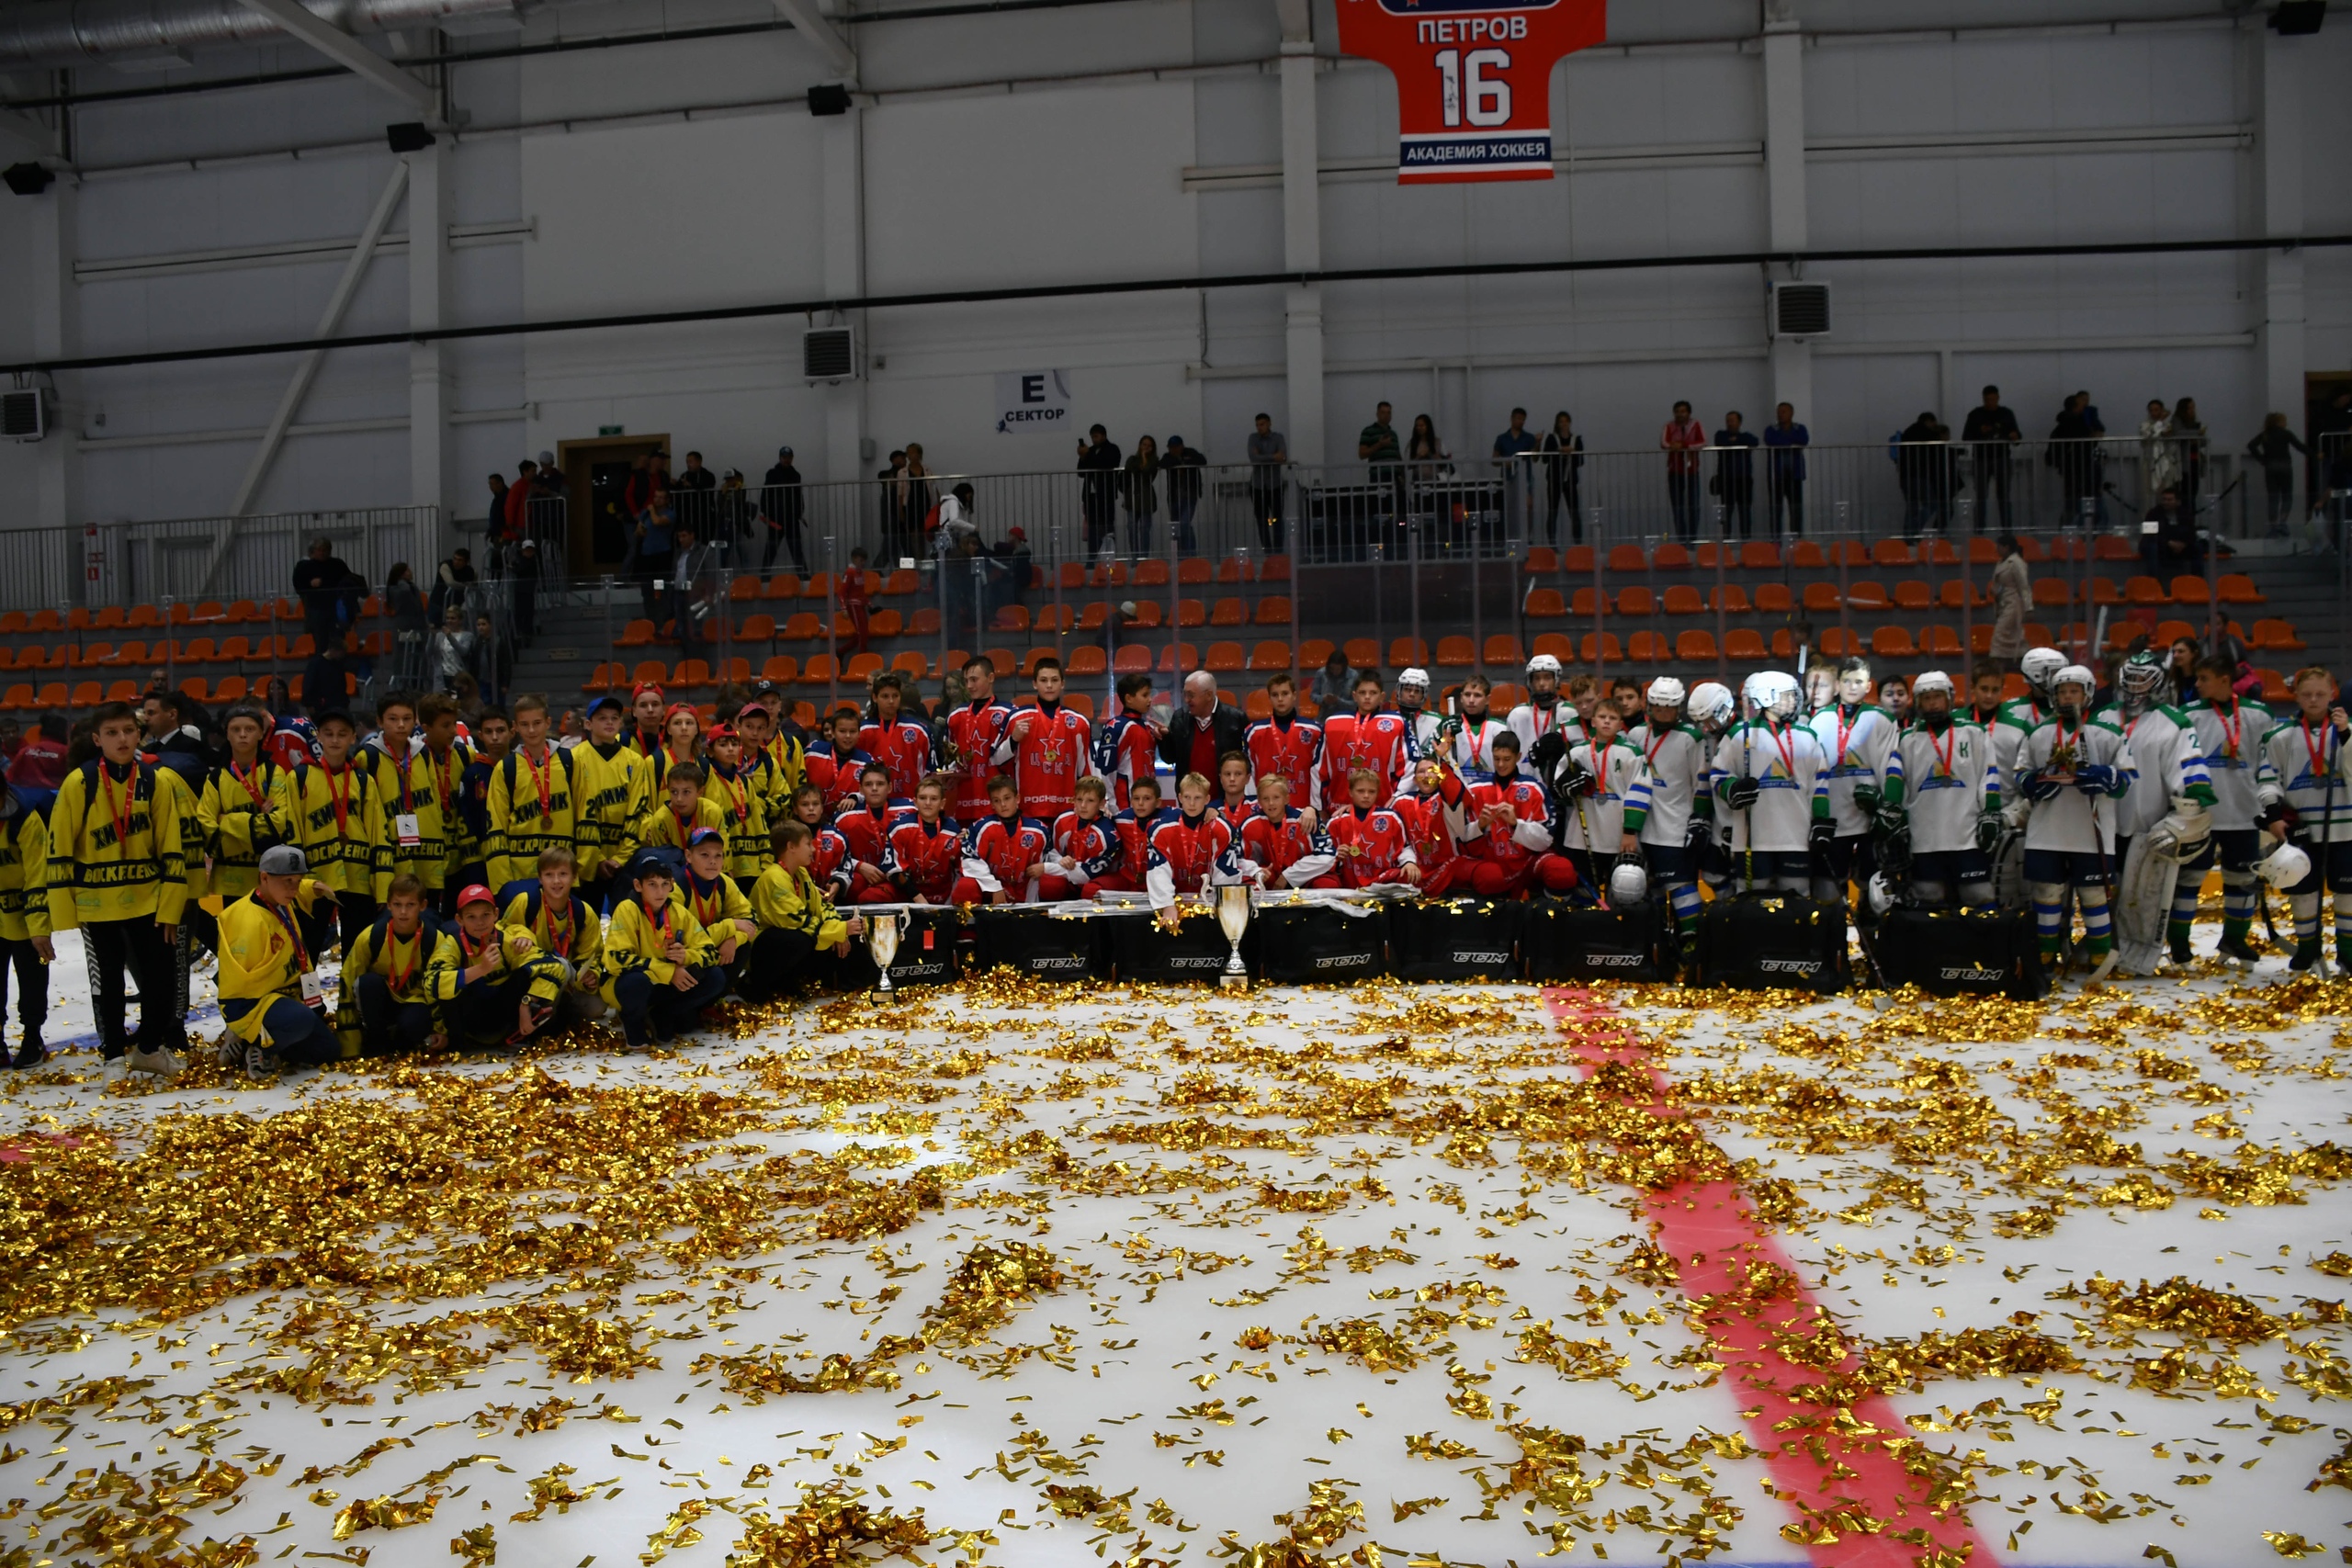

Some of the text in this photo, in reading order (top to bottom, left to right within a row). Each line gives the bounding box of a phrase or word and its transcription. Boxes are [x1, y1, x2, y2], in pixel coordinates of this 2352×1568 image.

[1418, 17, 1528, 43] ПЕТРОВ
[1435, 48, 1511, 127] 16
[1407, 141, 1545, 162] АКАДЕМИЯ ХОККЕЯ
[1023, 375, 1045, 403] Е
[1005, 409, 1064, 422] СЕКТОР
[1029, 751, 1071, 776] ЦСКА
[1103, 750, 1111, 766] 7
[1024, 795, 1075, 804] РОСНЕФТ
[179, 817, 202, 839] 20
[1032, 957, 1086, 969] CCM
[1170, 956, 1225, 968] CCM
[1316, 953, 1371, 968] CCM
[1453, 952, 1510, 964] CCM
[1586, 954, 1644, 966] CCM
[891, 964, 944, 976] CCM
[1760, 960, 1823, 974] CCM
[1940, 967, 2004, 981] CCM
